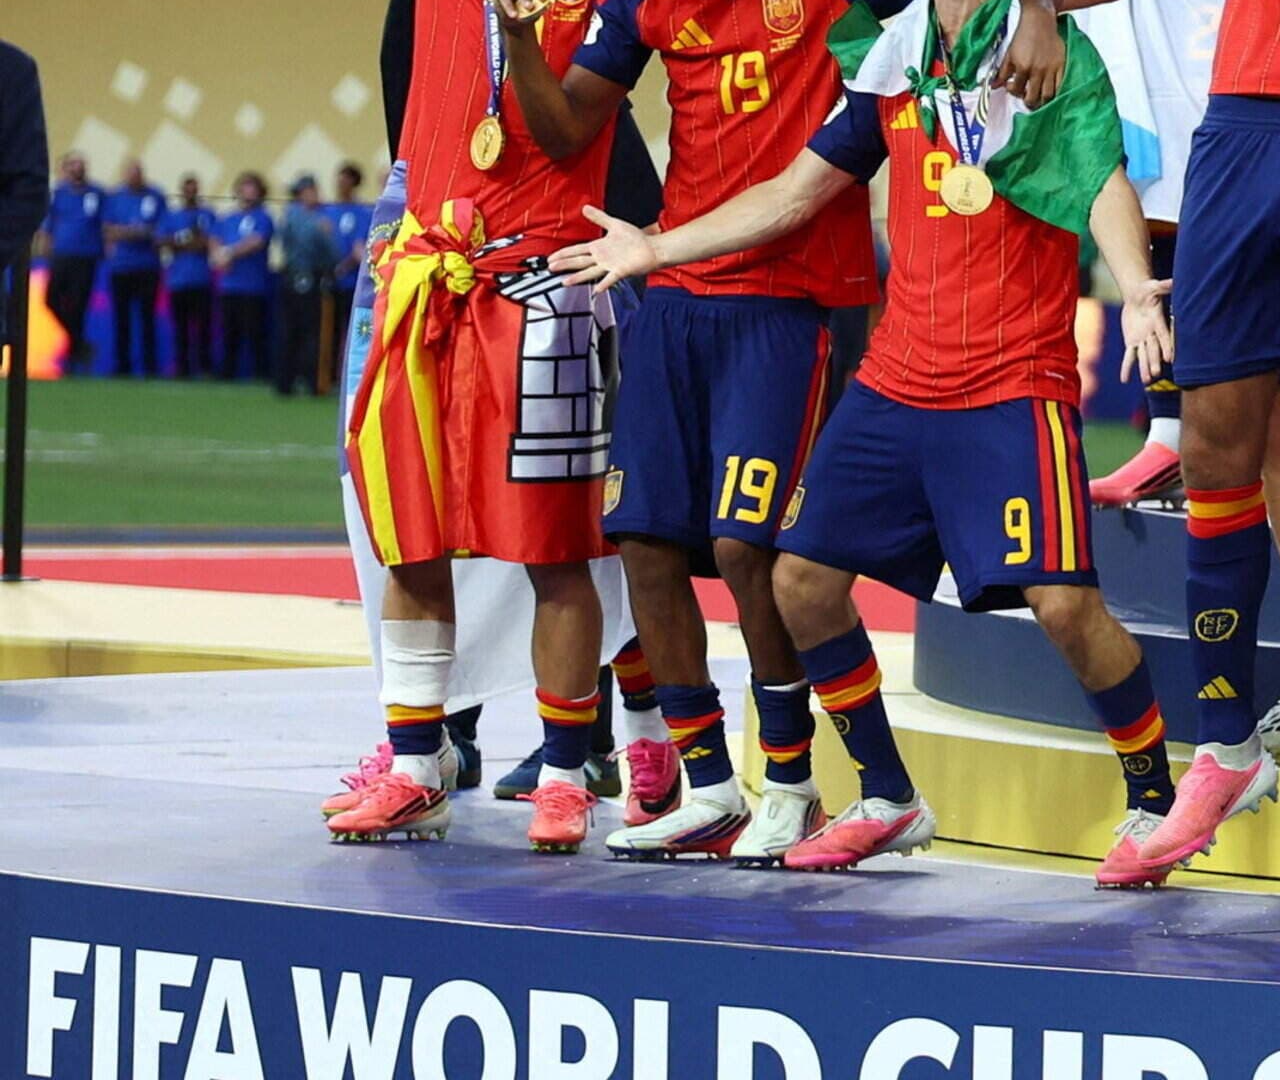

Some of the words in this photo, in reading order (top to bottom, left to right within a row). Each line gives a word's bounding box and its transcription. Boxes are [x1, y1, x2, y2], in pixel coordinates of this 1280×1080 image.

[720, 50, 771, 114] 19
[716, 455, 778, 524] 19
[1003, 496, 1034, 566] 9
[26, 936, 268, 1080] FIFA
